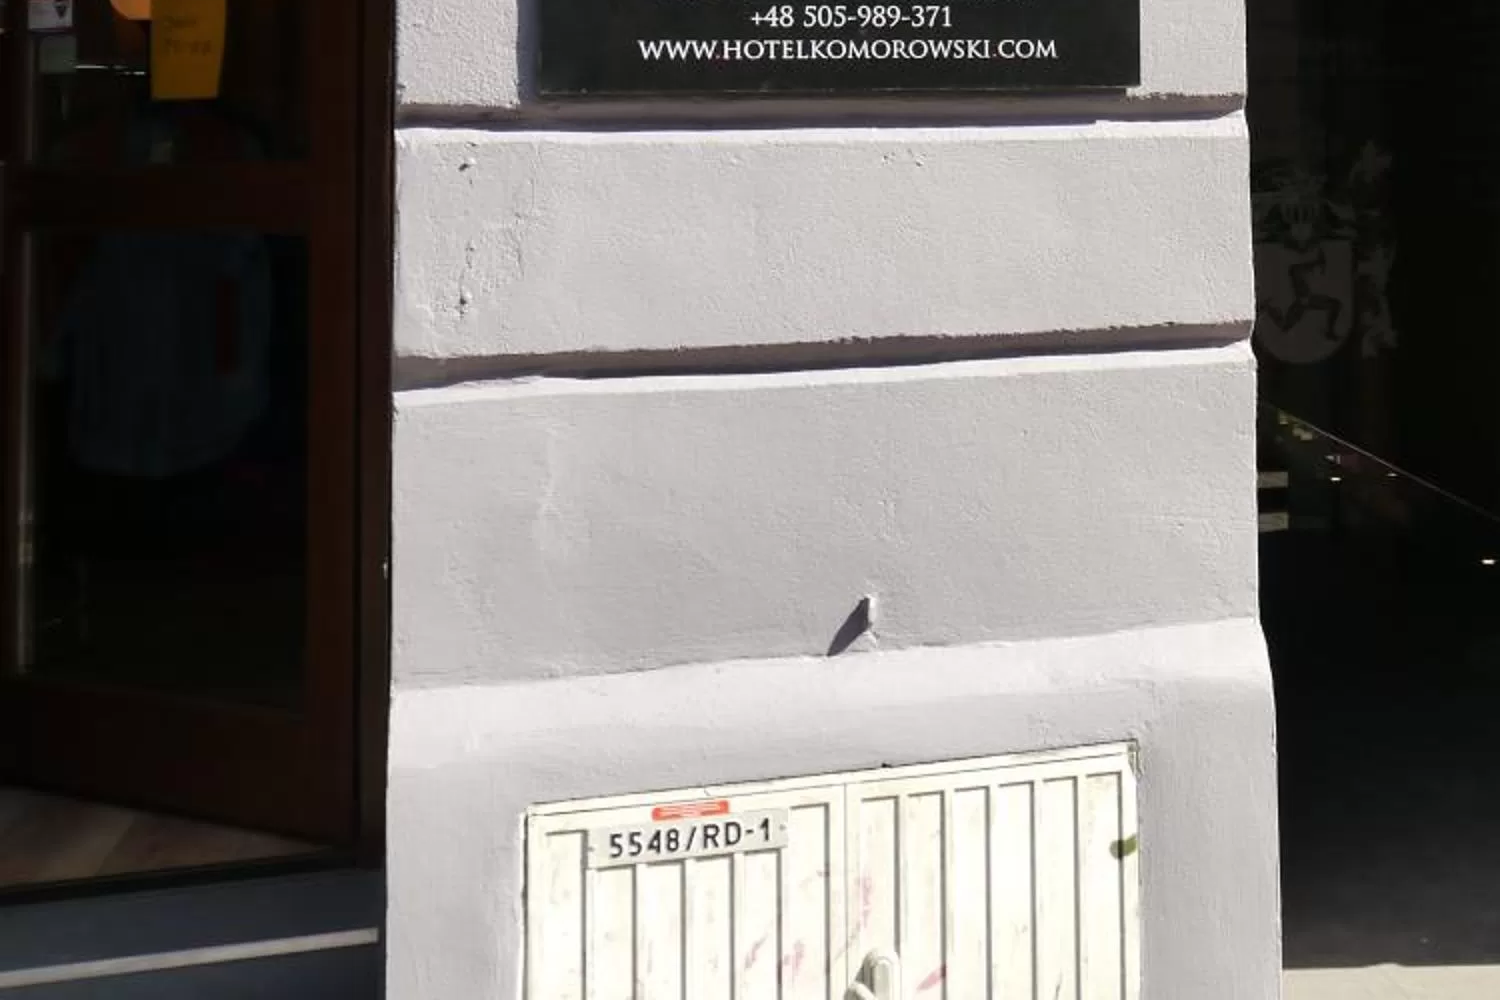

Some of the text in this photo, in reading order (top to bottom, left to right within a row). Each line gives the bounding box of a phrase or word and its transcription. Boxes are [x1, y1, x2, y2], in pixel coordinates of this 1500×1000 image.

[750, 4, 953, 29] +48 505-989-371
[637, 38, 1058, 61] WWW.HOTELKOMOROWSKI.COM
[610, 817, 771, 859] 5548/RD-1
